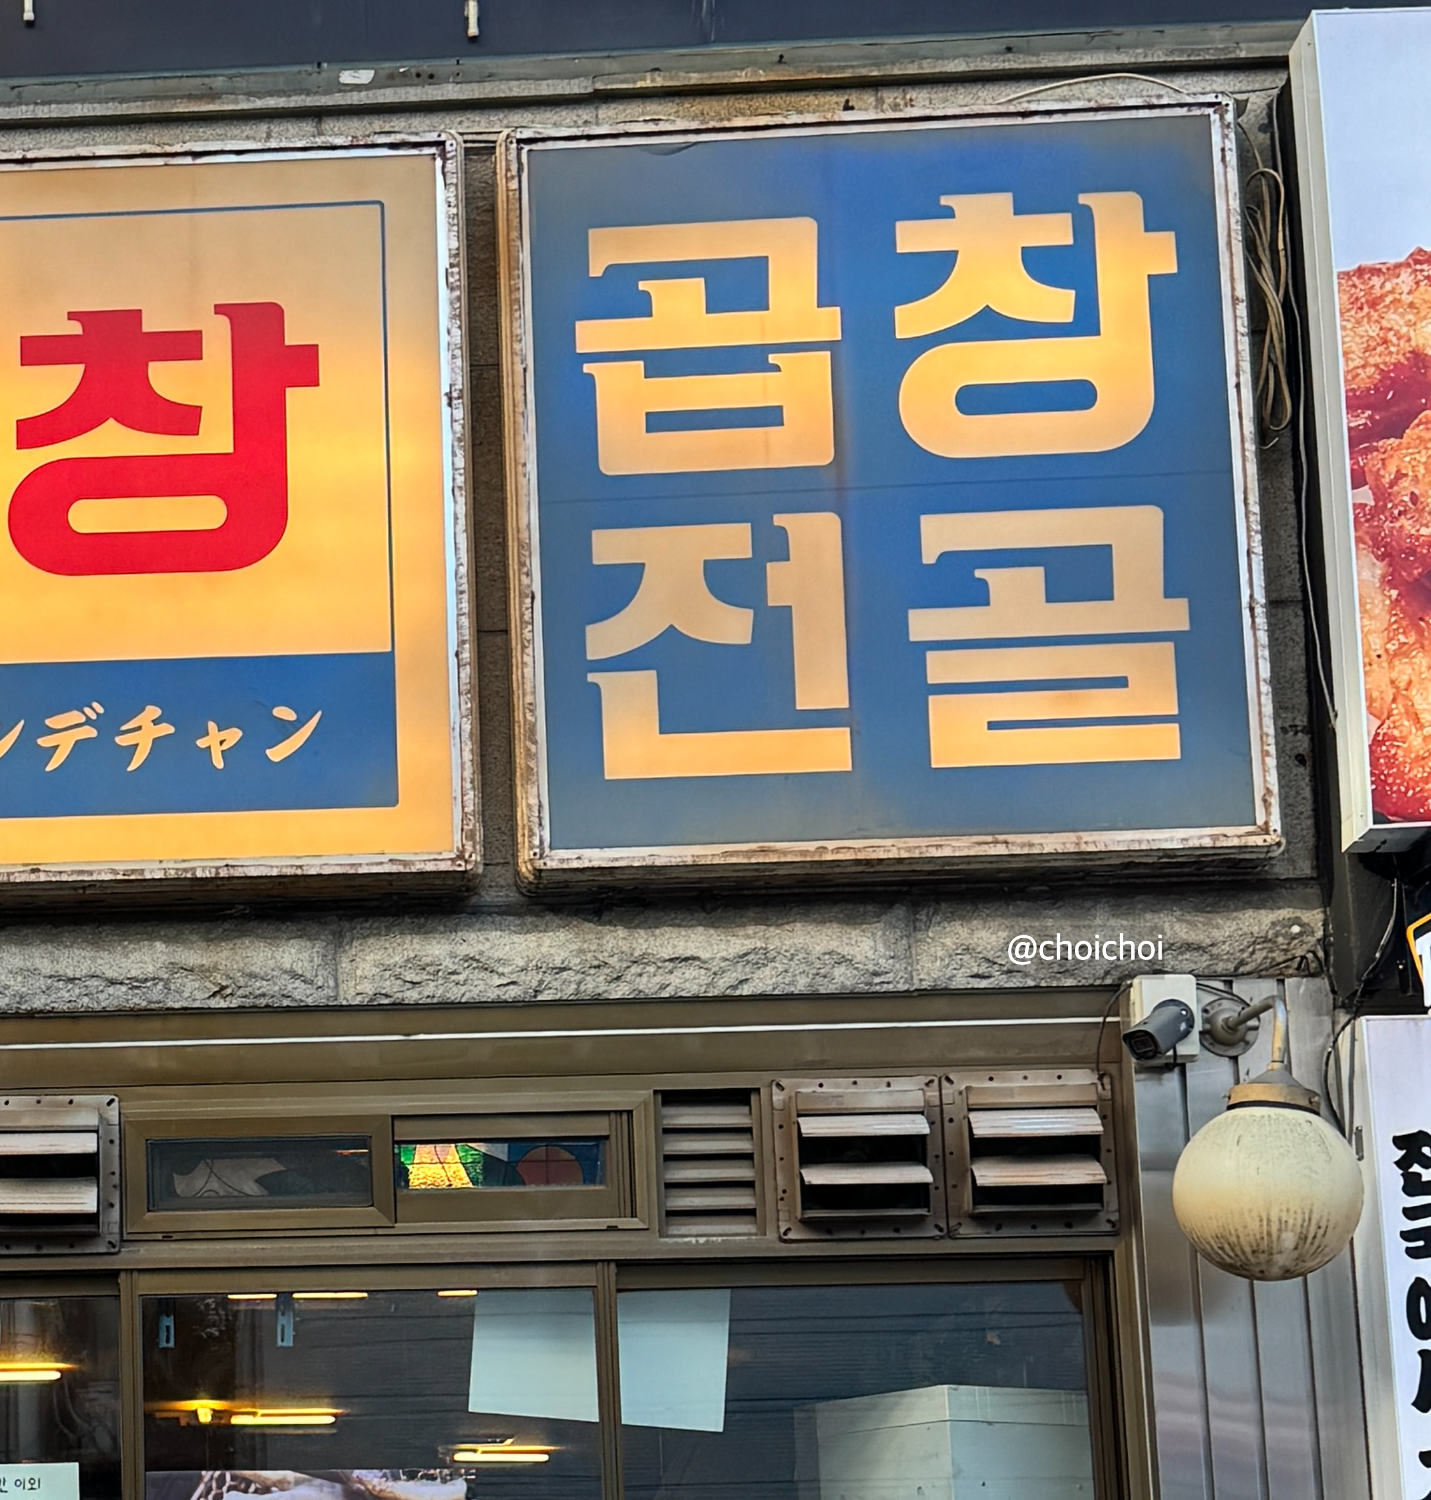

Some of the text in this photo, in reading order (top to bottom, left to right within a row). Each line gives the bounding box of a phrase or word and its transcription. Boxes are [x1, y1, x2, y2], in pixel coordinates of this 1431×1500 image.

[575, 190, 1178, 476] 곱창
[584, 505, 1190, 780] 전골
[14, 1477, 41, 1491] 이외
